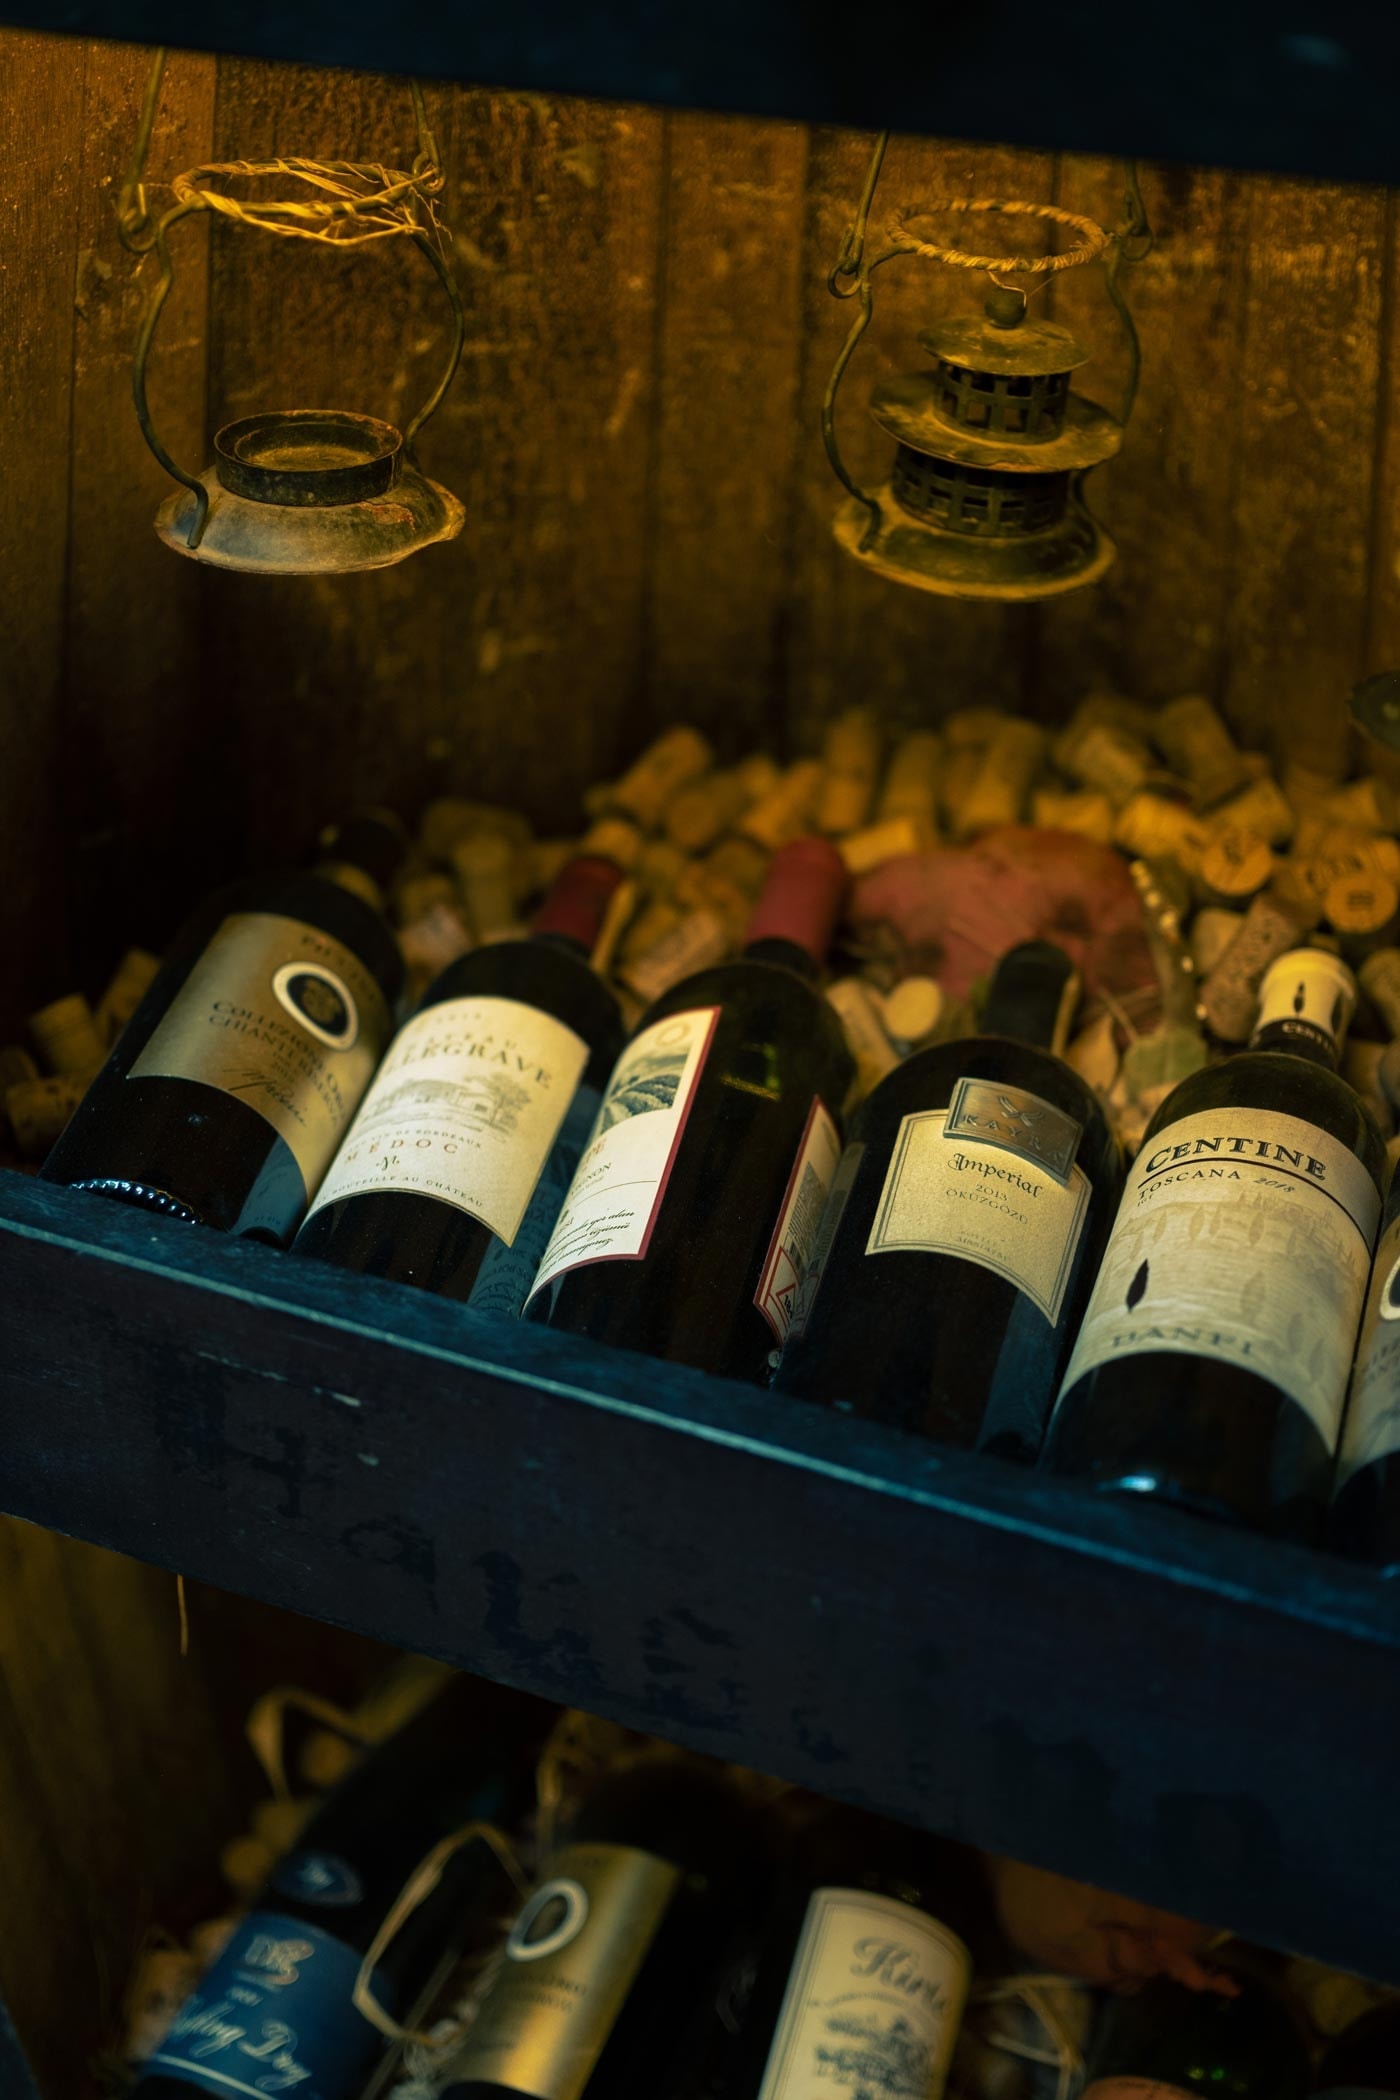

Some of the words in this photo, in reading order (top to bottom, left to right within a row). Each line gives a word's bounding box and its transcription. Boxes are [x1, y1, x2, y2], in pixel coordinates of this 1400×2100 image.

[947, 1152, 1045, 1199] Imperial
[1138, 1168, 1242, 1200] TOSCANA
[1252, 1176, 1297, 1194] 2018
[974, 1183, 1009, 1202] 2013
